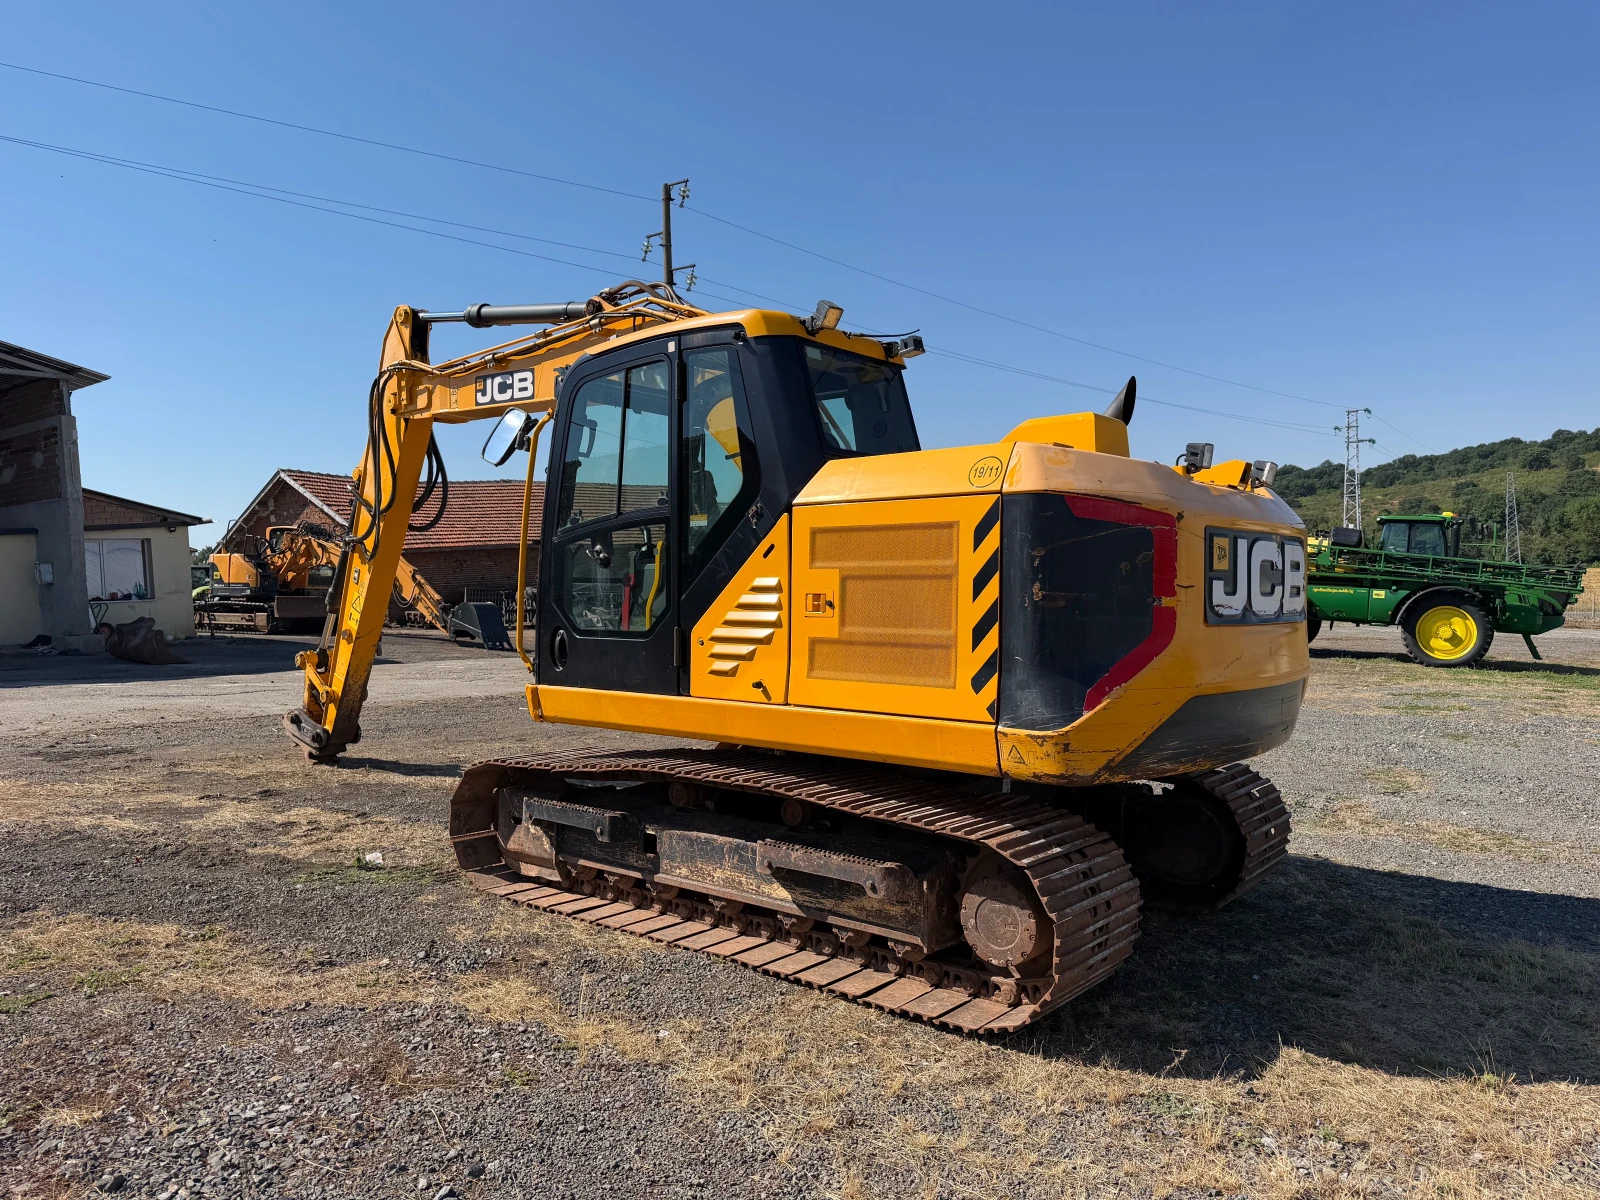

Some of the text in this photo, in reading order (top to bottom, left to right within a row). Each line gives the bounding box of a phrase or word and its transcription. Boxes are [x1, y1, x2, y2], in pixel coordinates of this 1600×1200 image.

[476, 371, 534, 404] JCB
[973, 465, 1000, 479] 19/11
[1212, 538, 1305, 615] JCB
